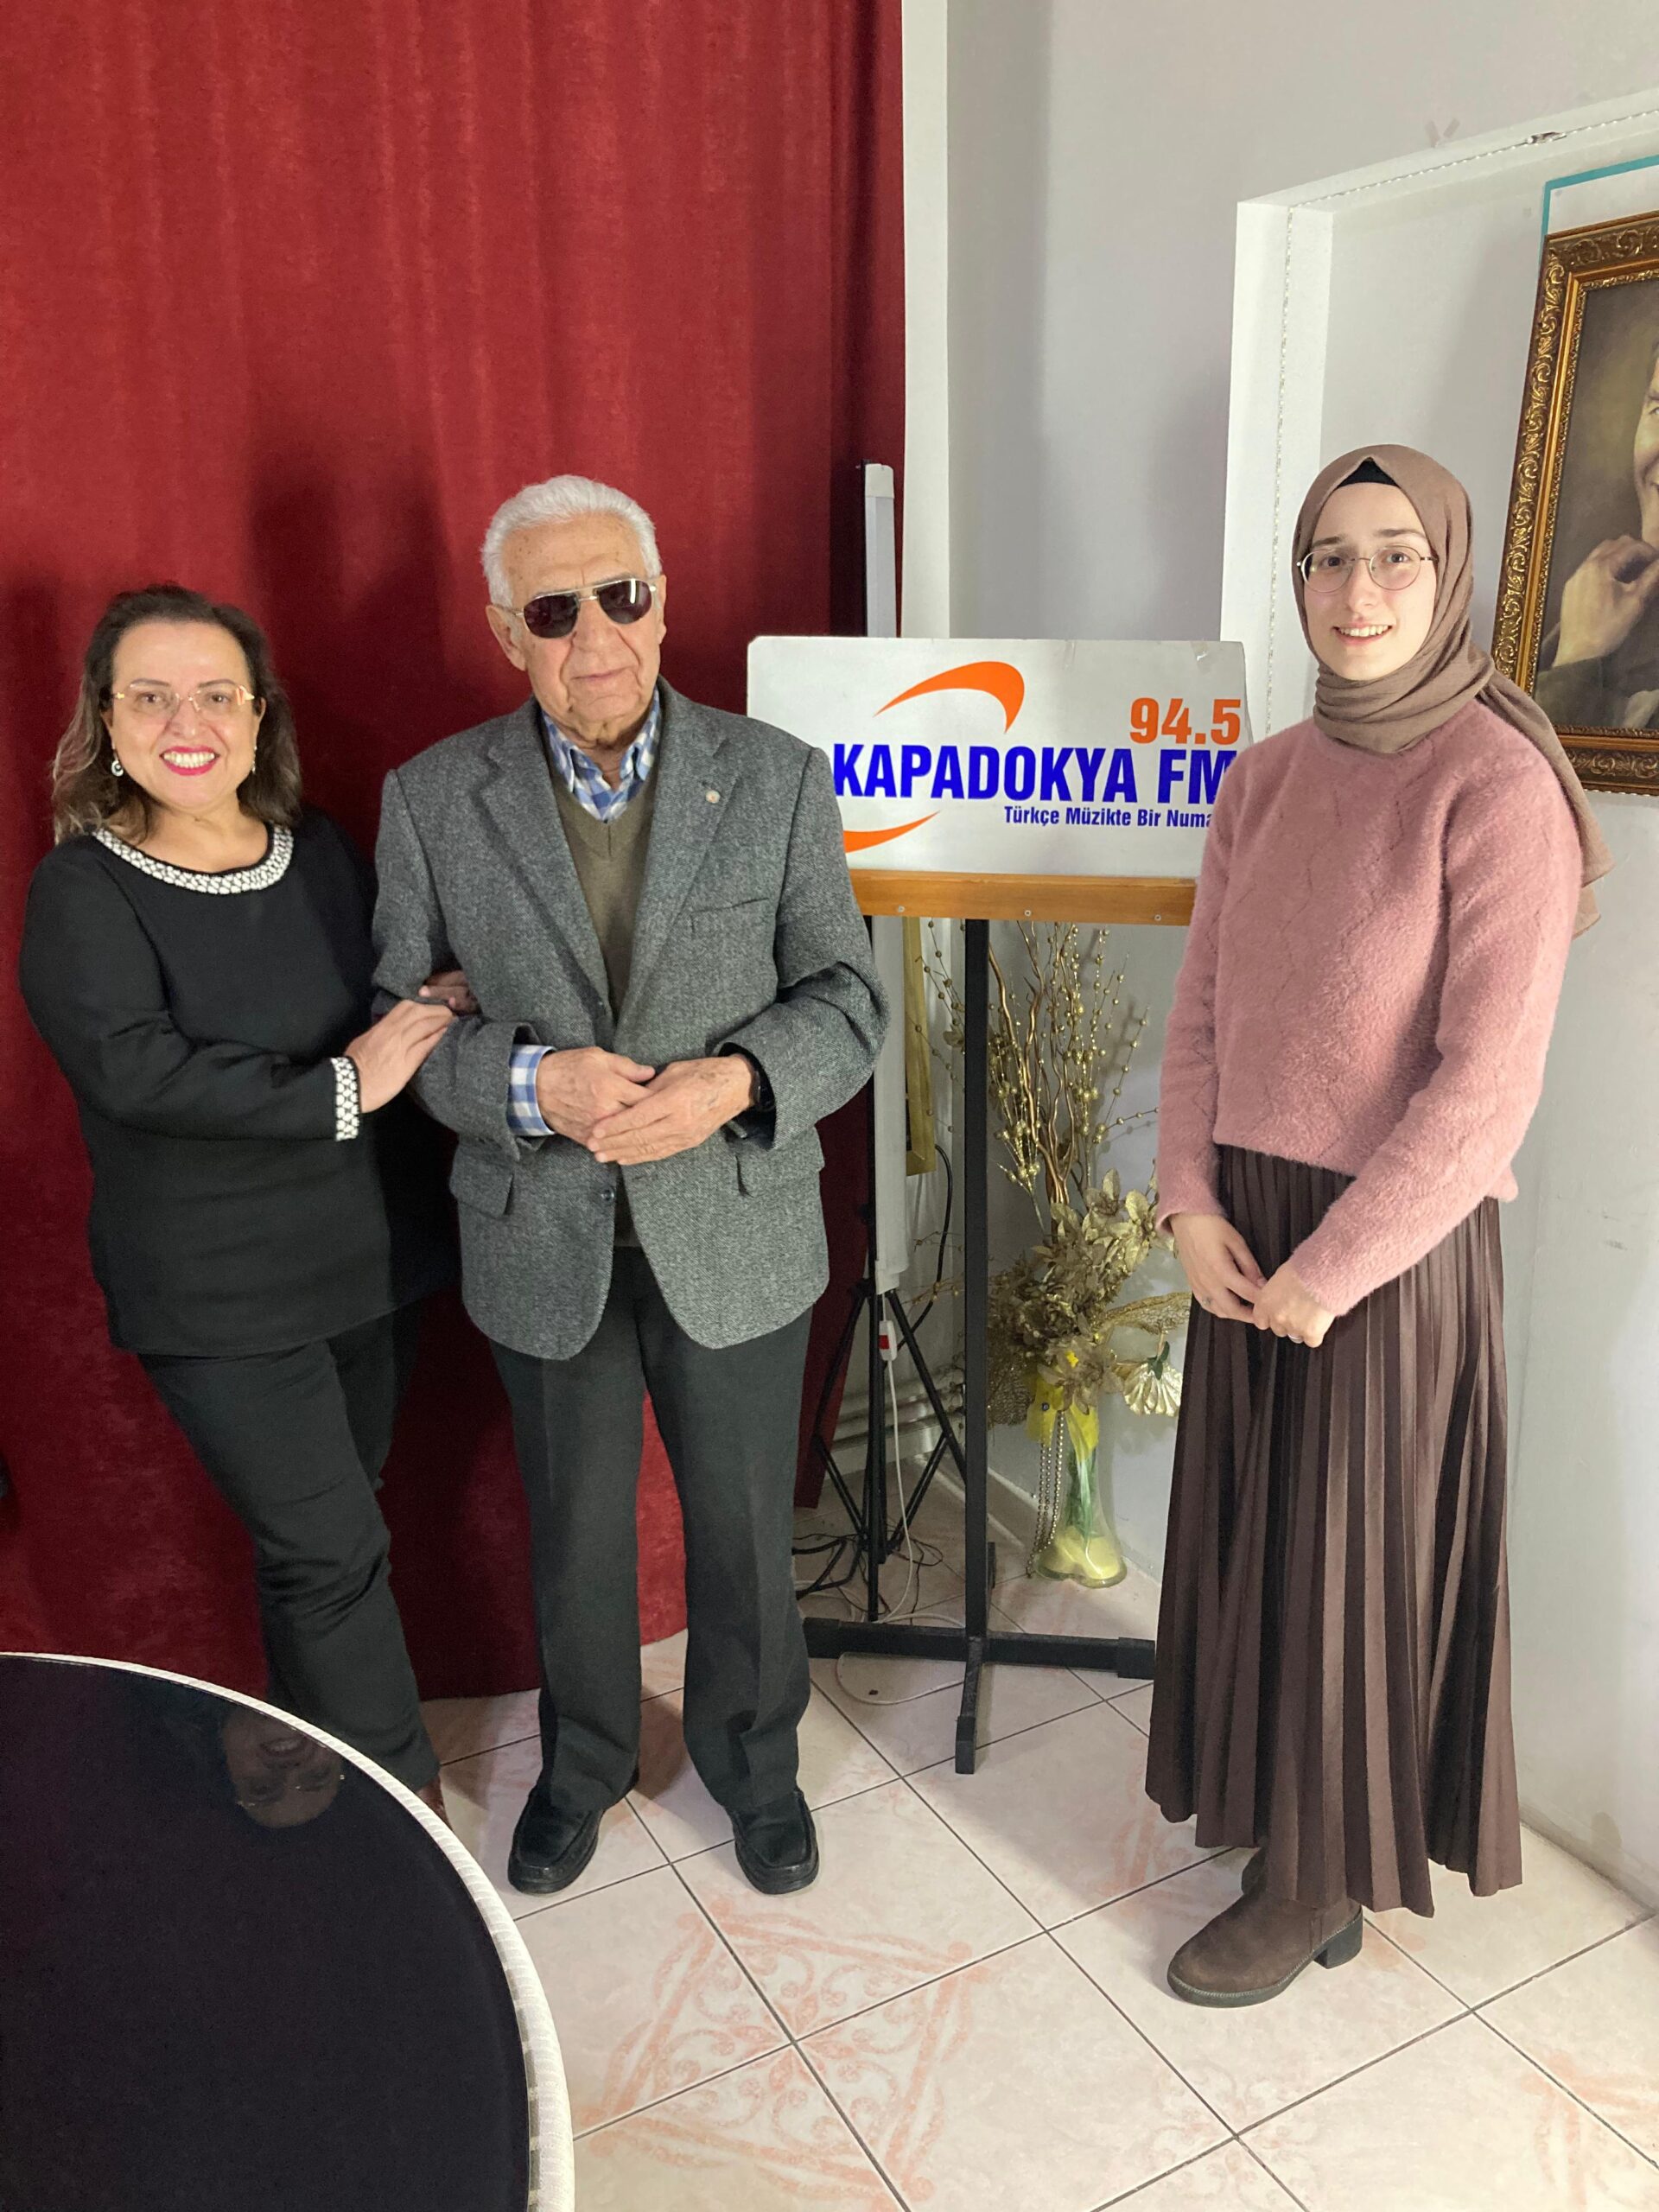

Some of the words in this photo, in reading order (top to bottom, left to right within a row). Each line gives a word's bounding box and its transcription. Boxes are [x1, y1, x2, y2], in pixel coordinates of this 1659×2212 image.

[1130, 697, 1241, 745] 94.5
[833, 743, 1138, 803] KAPADOKYA
[1157, 748, 1237, 804] FM
[1004, 805, 1059, 827] Türkçe
[1065, 807, 1131, 826] Müzikte
[1137, 809, 1161, 827] Bir
